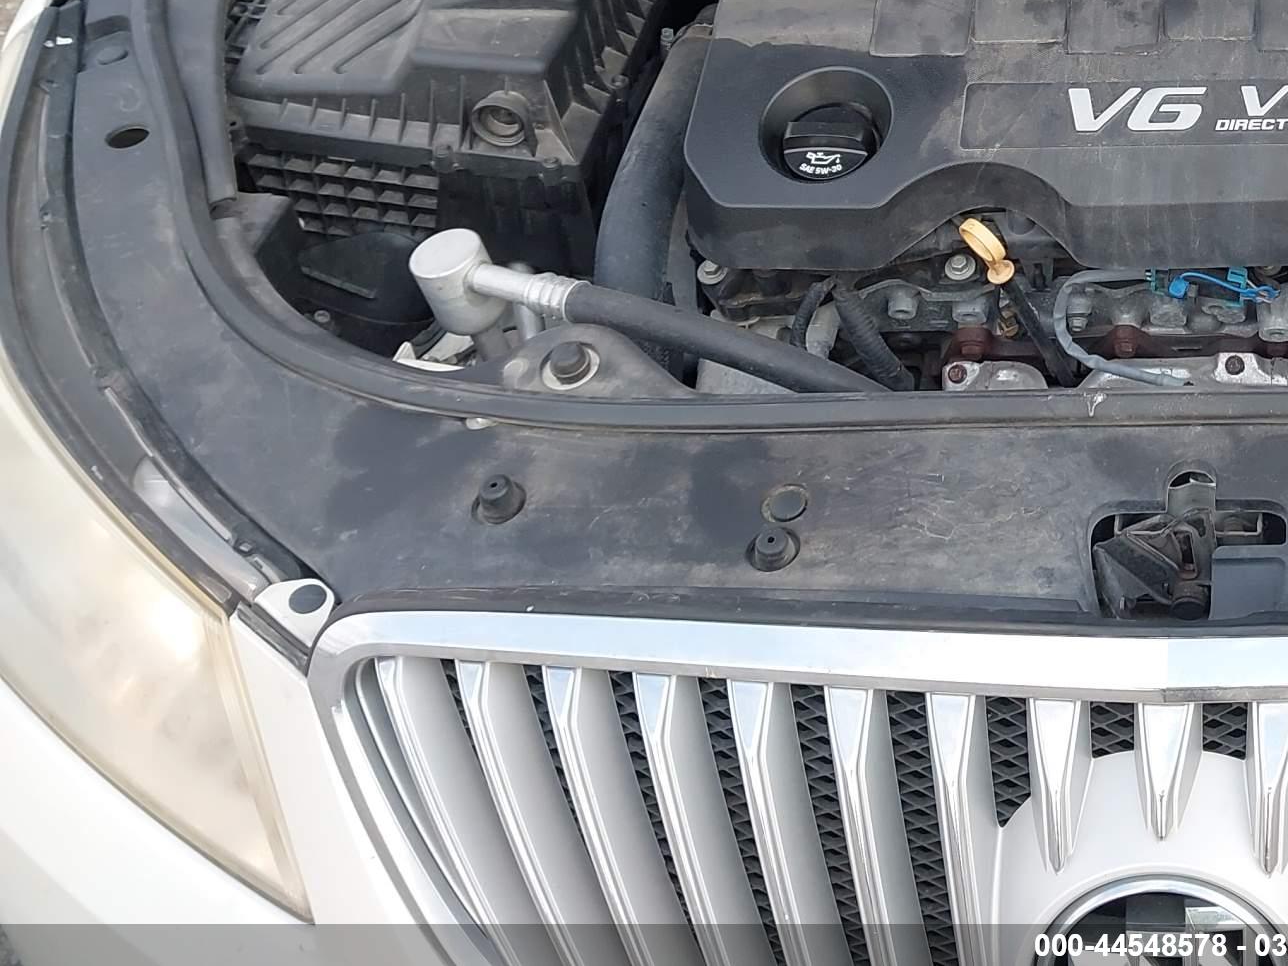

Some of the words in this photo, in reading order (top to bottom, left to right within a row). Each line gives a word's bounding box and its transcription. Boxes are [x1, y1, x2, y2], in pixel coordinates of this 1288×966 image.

[1068, 87, 1207, 131] V6
[1215, 118, 1288, 131] DIRECT
[799, 163, 815, 174] SAE
[815, 164, 843, 175] 5W-30
